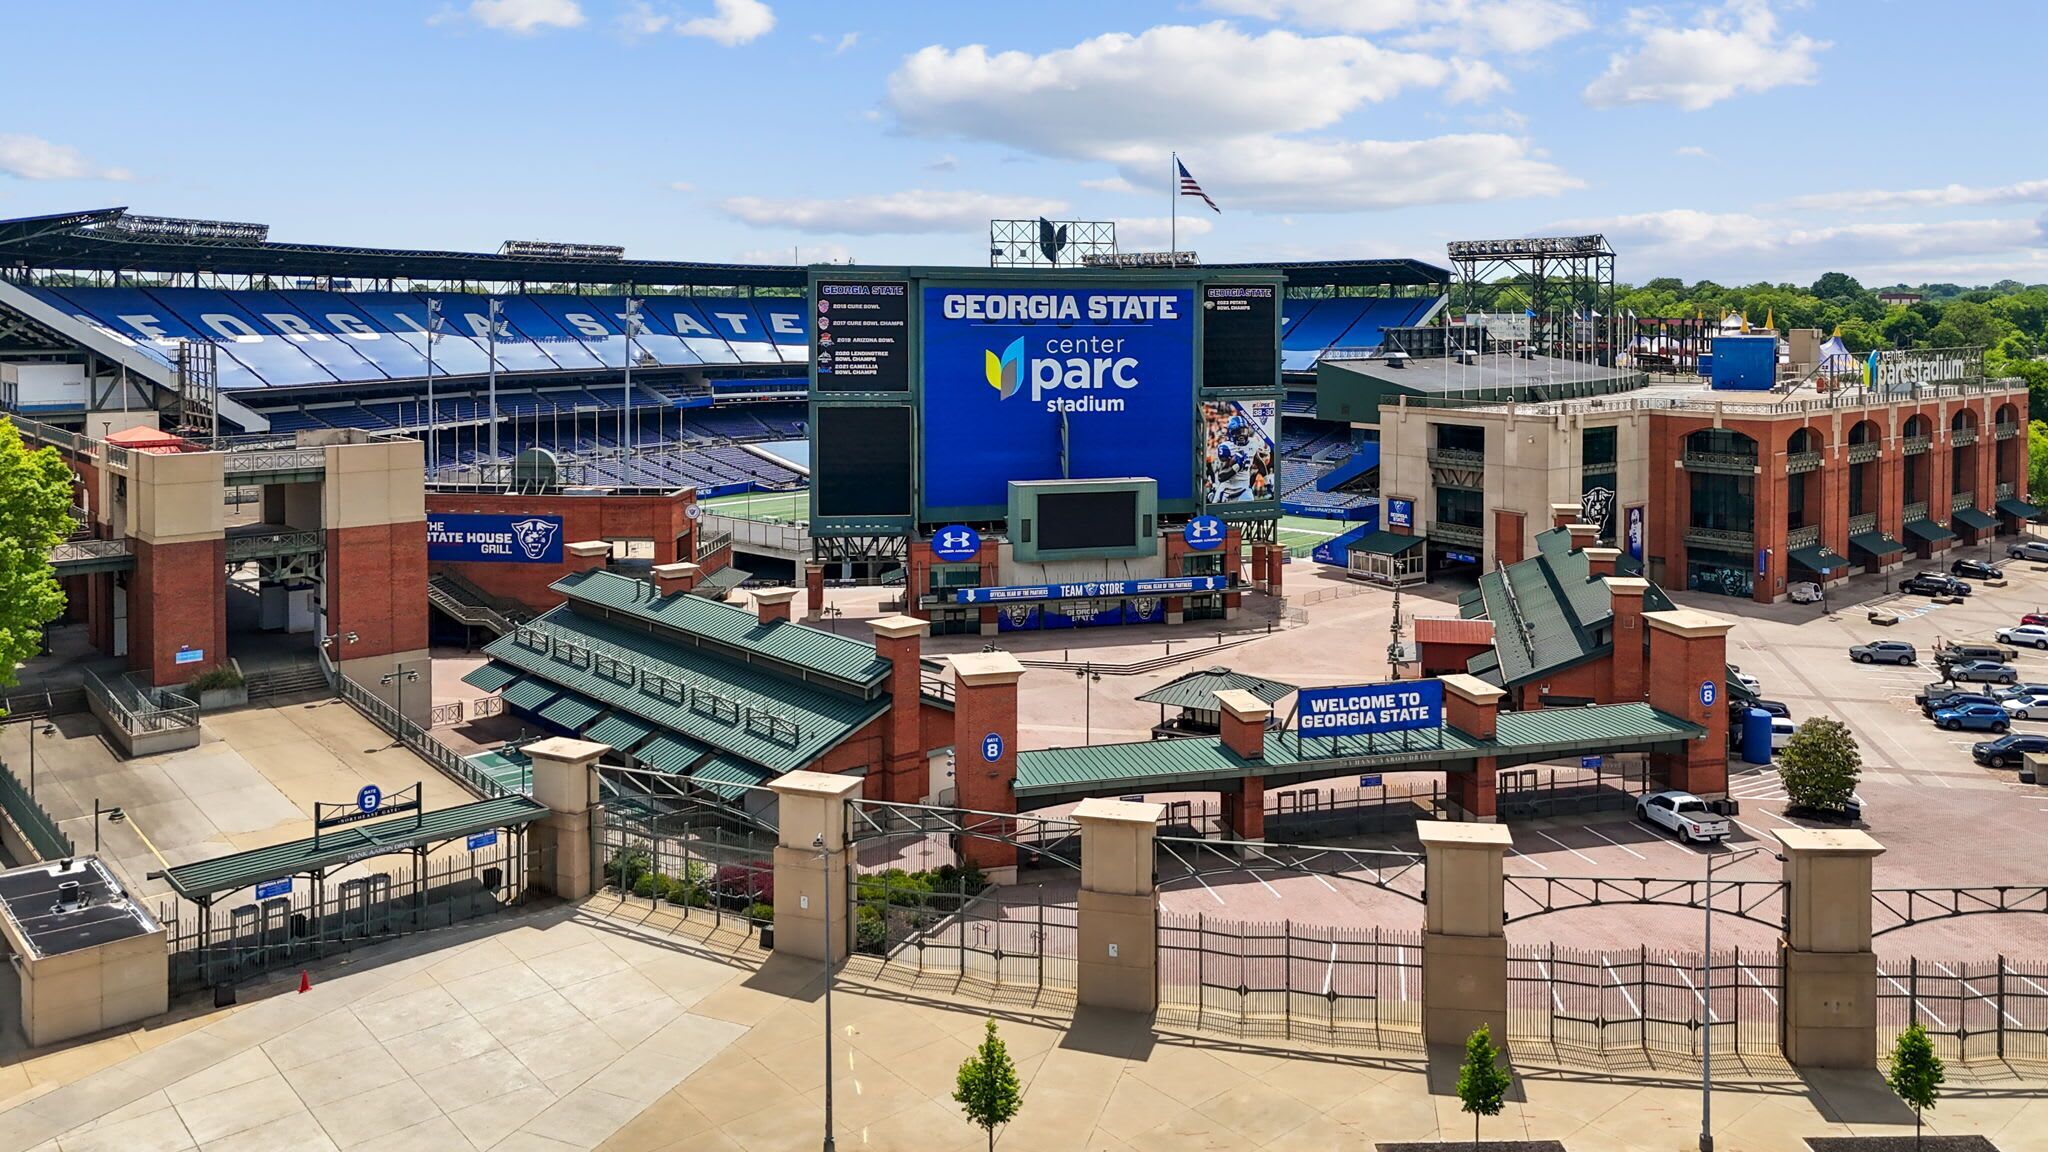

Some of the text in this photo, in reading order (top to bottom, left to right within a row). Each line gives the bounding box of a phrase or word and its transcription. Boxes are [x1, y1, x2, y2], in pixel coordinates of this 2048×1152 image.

[823, 285, 904, 296] GEORGIA STATE
[1208, 288, 1272, 297] GEORGIA STATE
[943, 294, 1178, 319] GEORGIA STATE
[565, 312, 804, 336] STATE
[1046, 335, 1125, 354] center
[1882, 349, 1906, 361] center
[1031, 357, 1139, 401] parc
[1878, 353, 1965, 393] parc stadium
[1046, 396, 1125, 412] stadium
[427, 532, 513, 543] STATE HOUSE
[481, 544, 513, 554] GRILL
[1060, 583, 1125, 597] TEAM STORE
[1066, 608, 1099, 616] GEORGIA
[1311, 692, 1420, 713] WELCOME TO
[1704, 689, 1713, 702] 8
[1301, 706, 1429, 728] GEORGIA STATE
[987, 743, 999, 757] 8
[1355, 758, 1376, 766] HANK
[1380, 756, 1406, 764] AARON
[1409, 753, 1433, 761] DRIVE
[364, 794, 376, 808] 9
[347, 839, 416, 861] HANK AARON DRIVE
